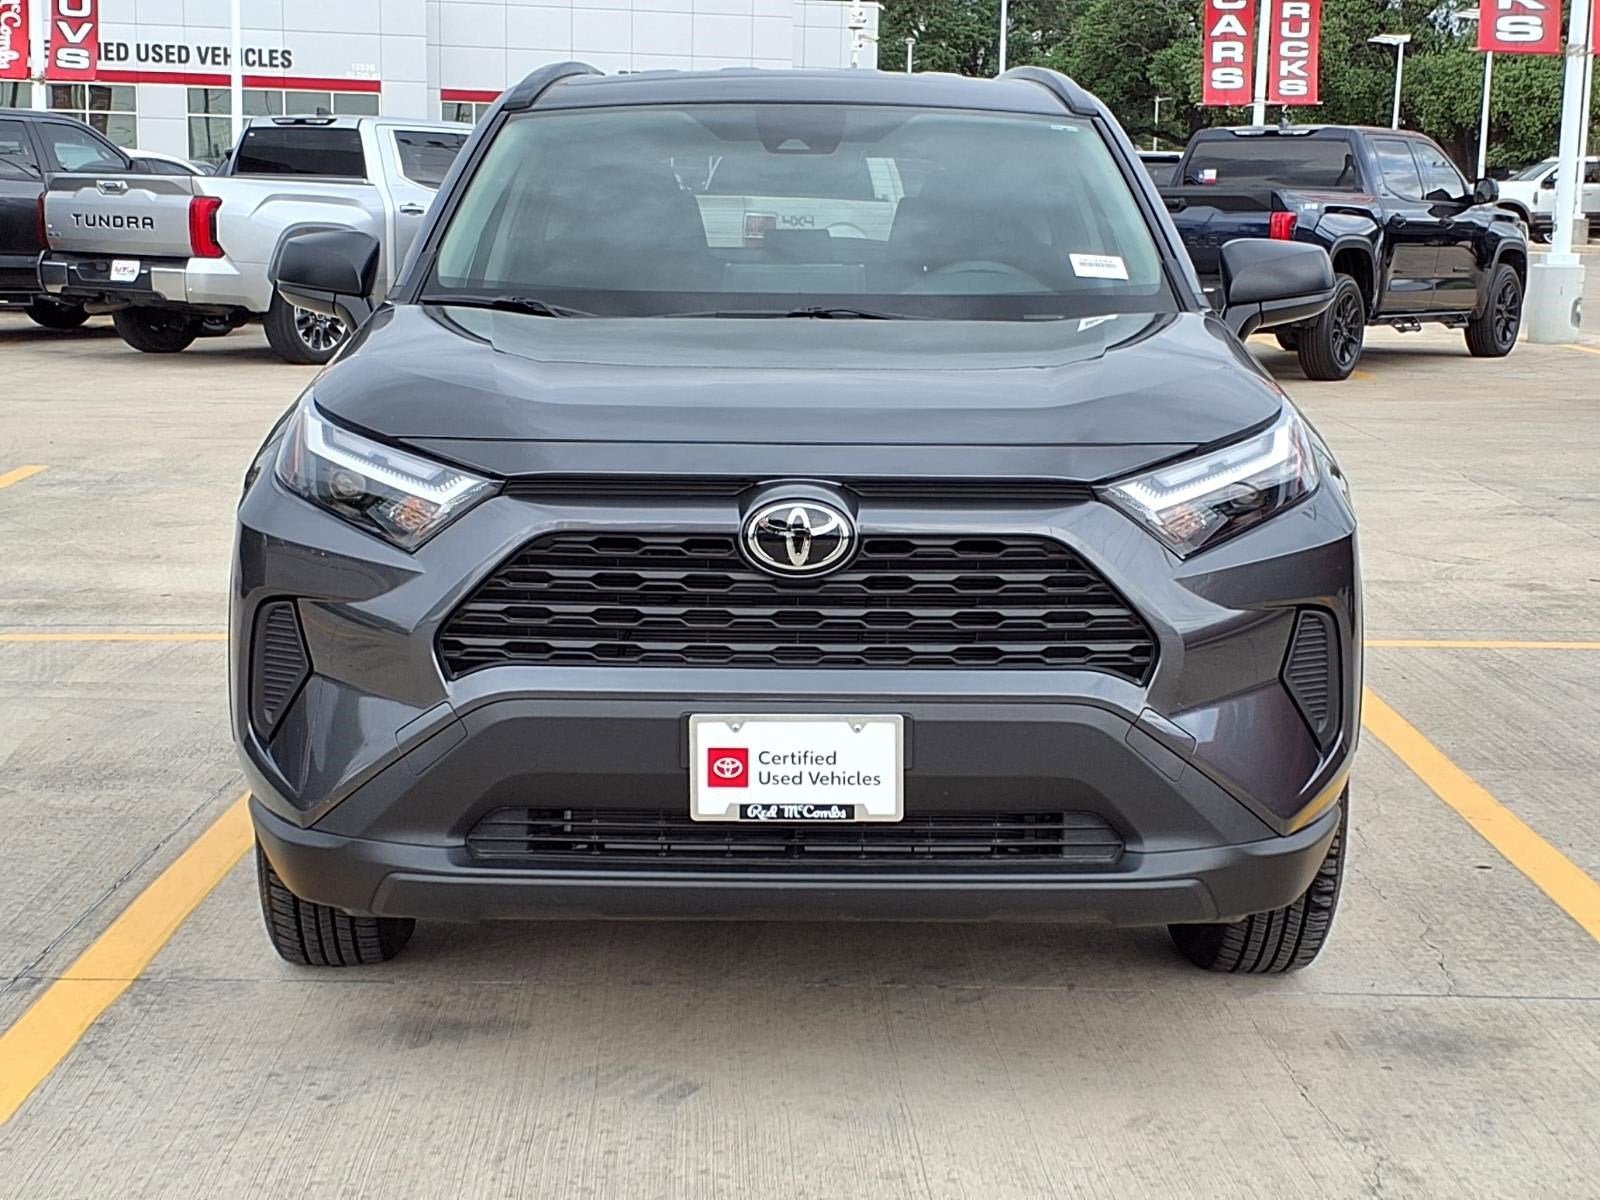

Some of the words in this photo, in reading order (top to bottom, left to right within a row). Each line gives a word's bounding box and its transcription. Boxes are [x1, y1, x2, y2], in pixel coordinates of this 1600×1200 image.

[136, 43, 190, 64] USED
[72, 213, 154, 229] TUNDRA
[758, 750, 837, 765] Certified
[758, 770, 803, 785] Used
[808, 770, 881, 786] Vehicles
[746, 804, 778, 820] Red
